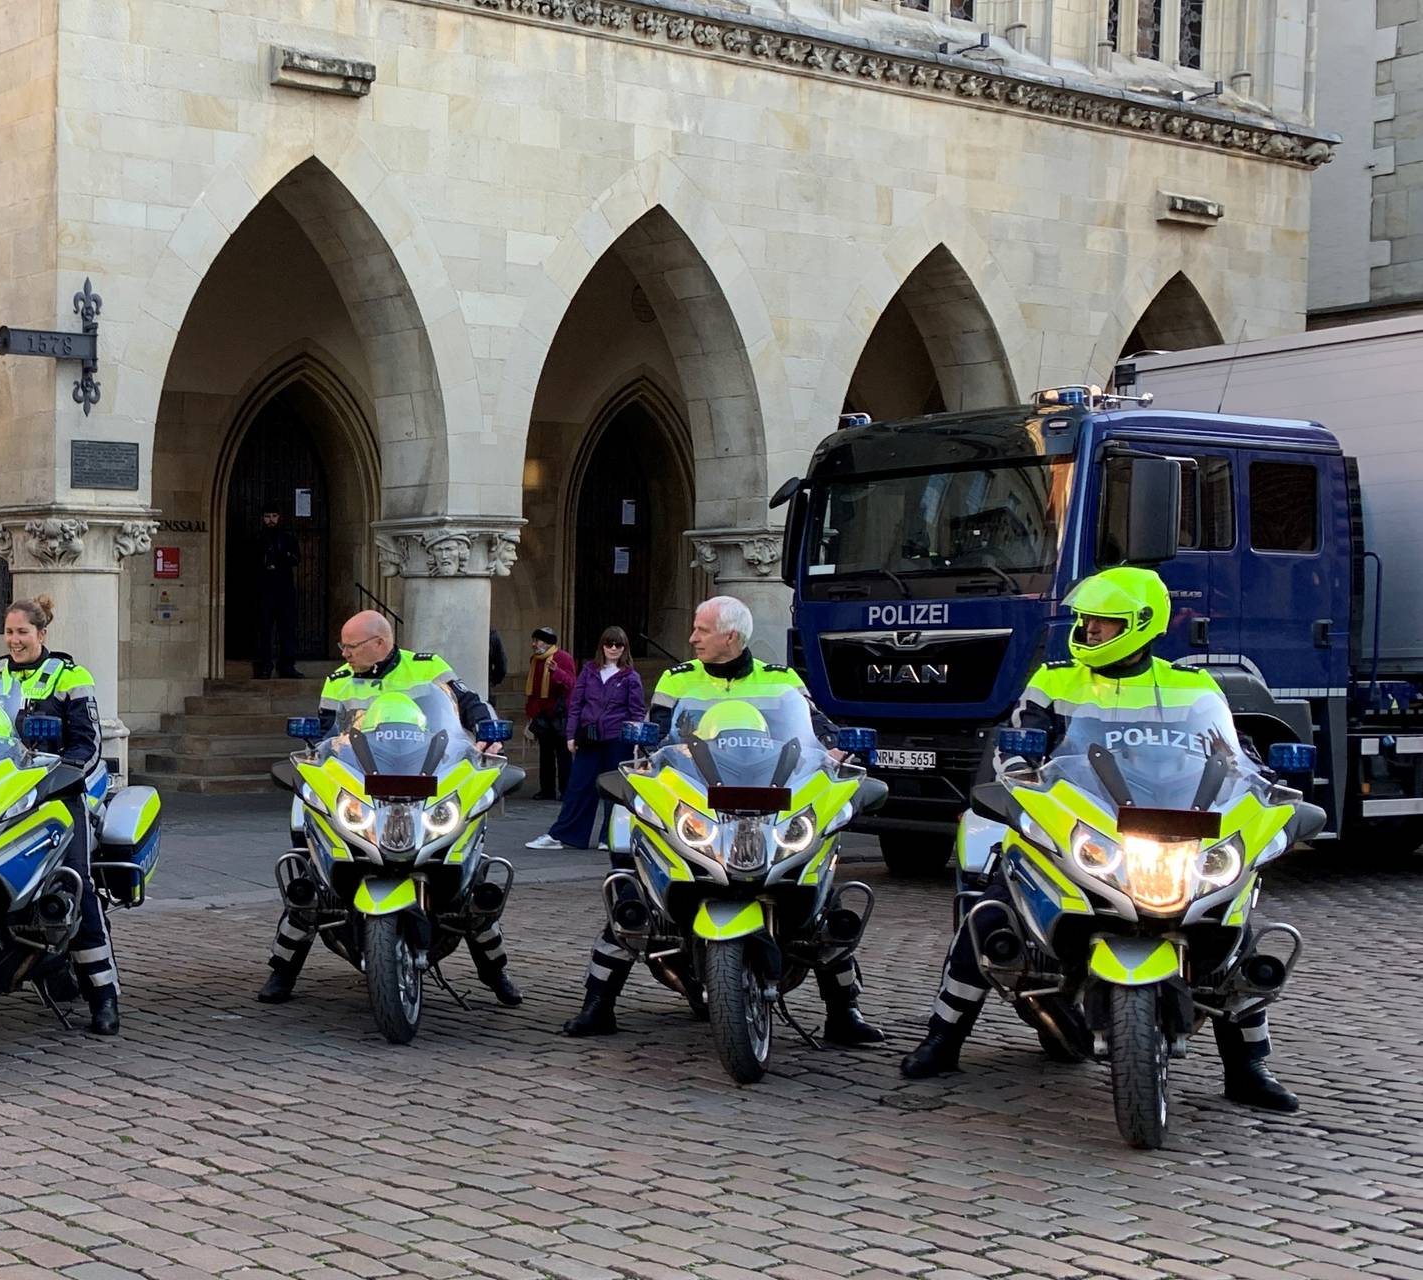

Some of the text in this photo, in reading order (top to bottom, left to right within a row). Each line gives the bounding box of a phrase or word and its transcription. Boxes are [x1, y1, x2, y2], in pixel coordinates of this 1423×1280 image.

[27, 334, 73, 356] 1578
[154, 519, 210, 532] ENSSAAL
[868, 603, 949, 626] POLIZEI
[867, 664, 948, 684] MAN
[375, 730, 426, 742] POLIZEI
[718, 736, 774, 750] POLIZEI
[1104, 728, 1212, 757] POLIZEI
